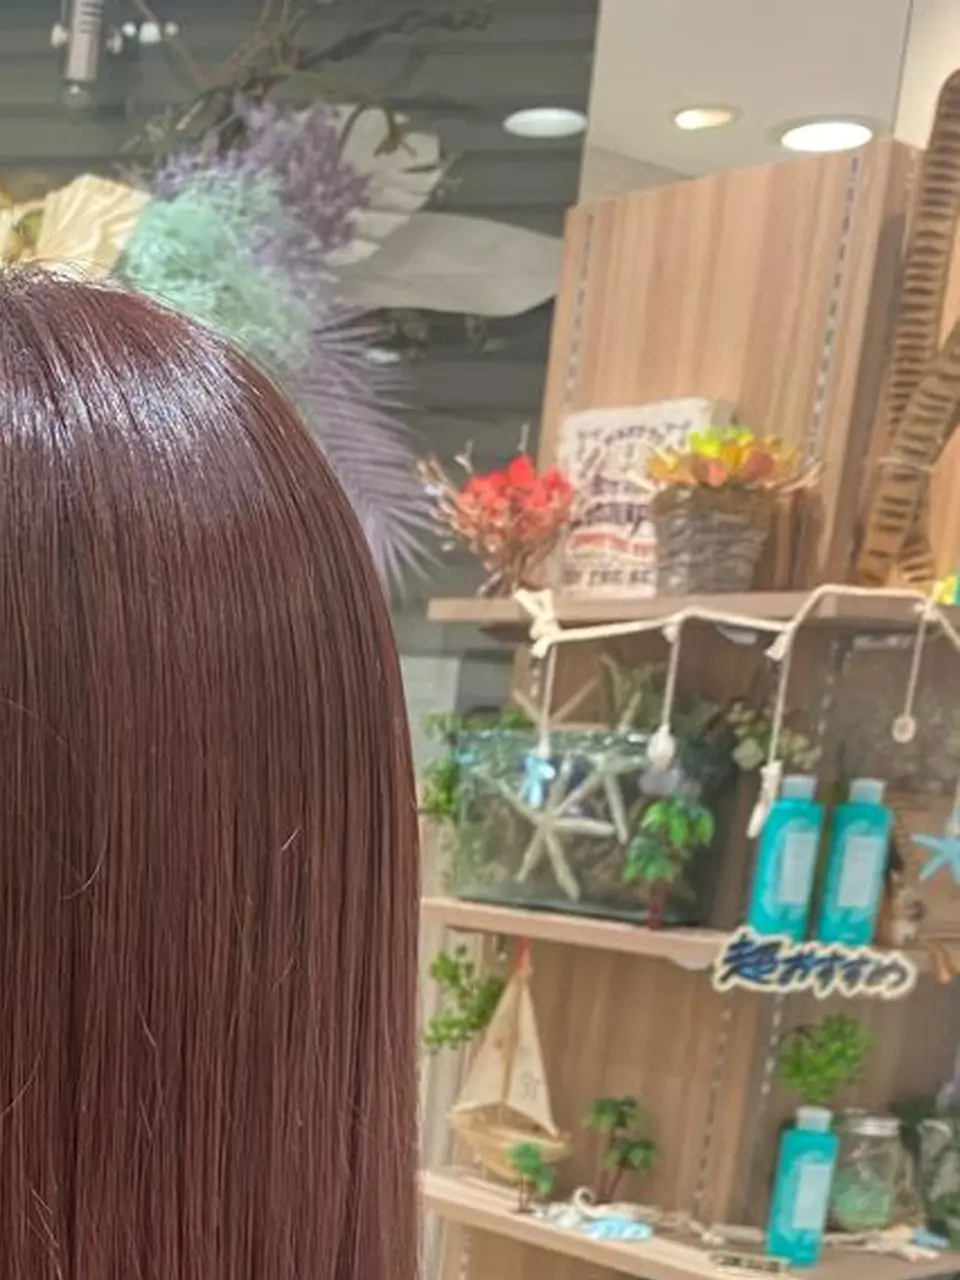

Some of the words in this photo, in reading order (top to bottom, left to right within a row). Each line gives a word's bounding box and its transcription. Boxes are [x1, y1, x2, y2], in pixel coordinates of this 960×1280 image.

[719, 932, 910, 990] 超おすすめ
